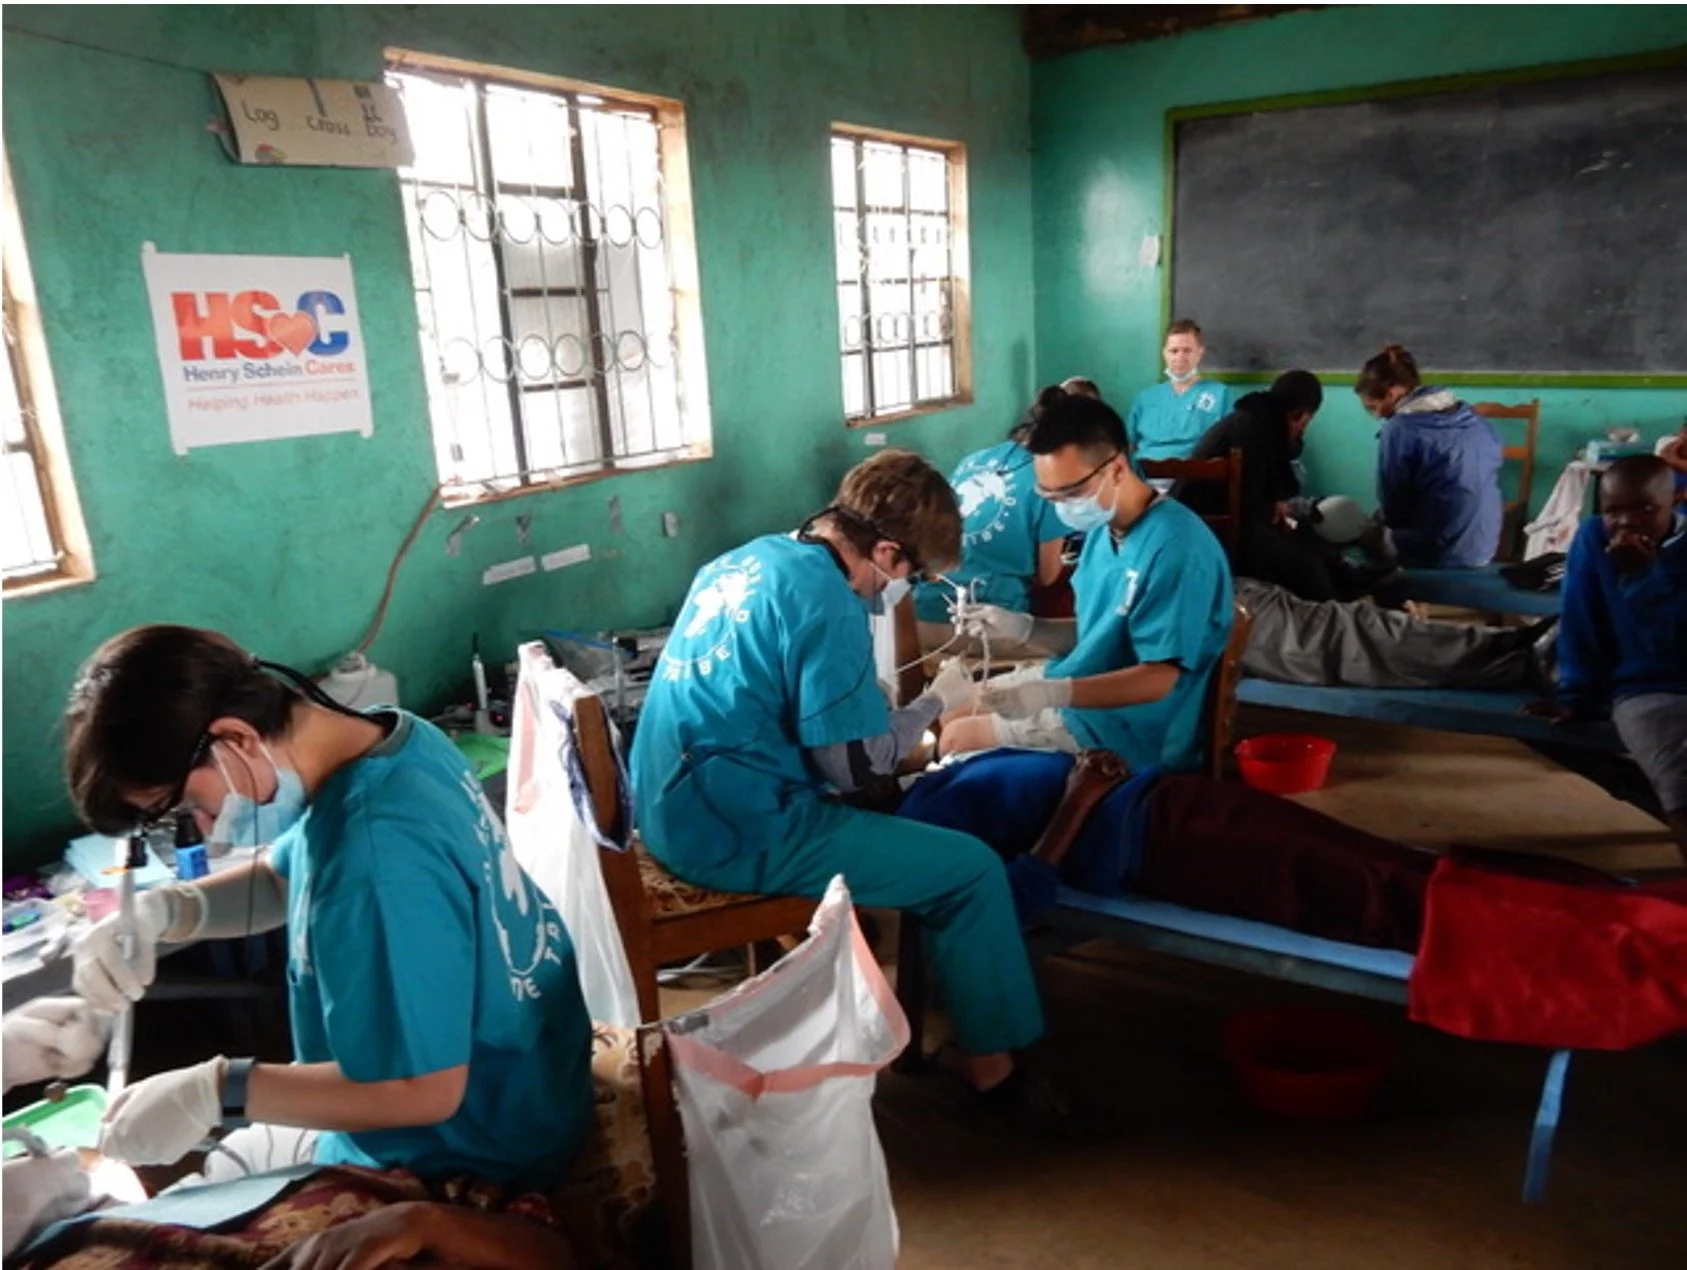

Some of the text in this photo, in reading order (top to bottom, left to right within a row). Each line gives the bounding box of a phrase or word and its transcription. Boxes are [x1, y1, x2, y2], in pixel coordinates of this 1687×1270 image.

[183, 358, 356, 383] Henry Schein Cares
[188, 394, 249, 413] Helping
[254, 390, 300, 407] Health
